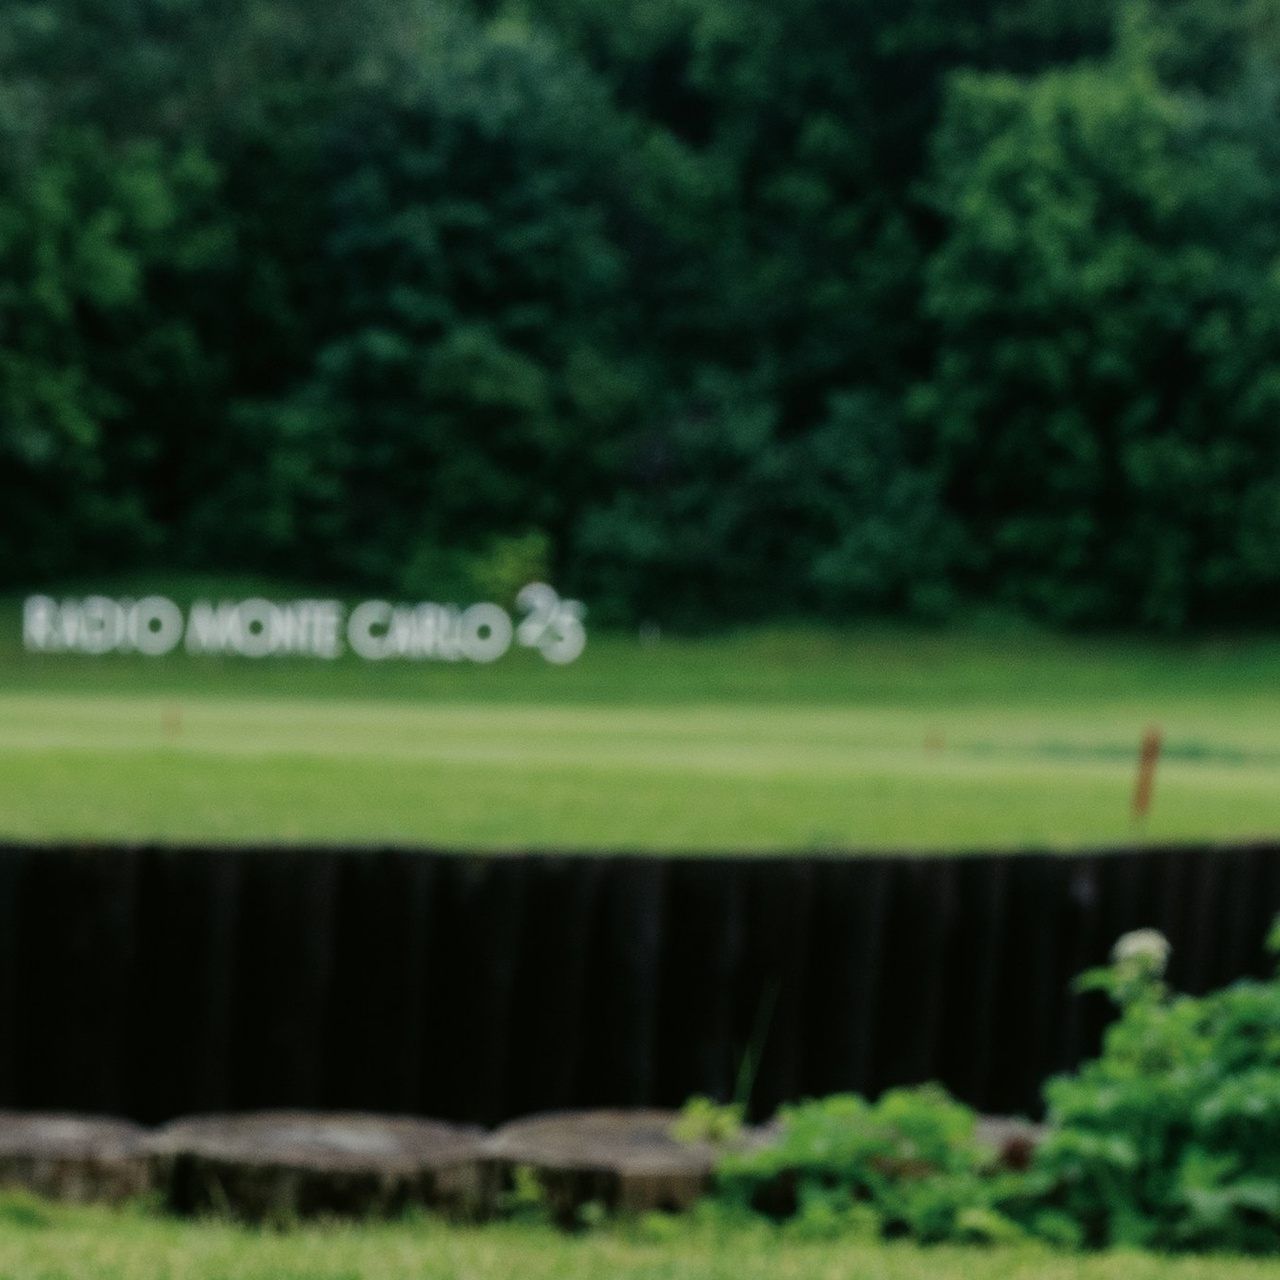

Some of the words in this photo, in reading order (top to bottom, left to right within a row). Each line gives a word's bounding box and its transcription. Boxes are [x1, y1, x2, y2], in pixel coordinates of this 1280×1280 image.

[24, 595, 183, 655] RADIO
[187, 598, 342, 660] MONTE
[347, 599, 513, 662] CARLO
